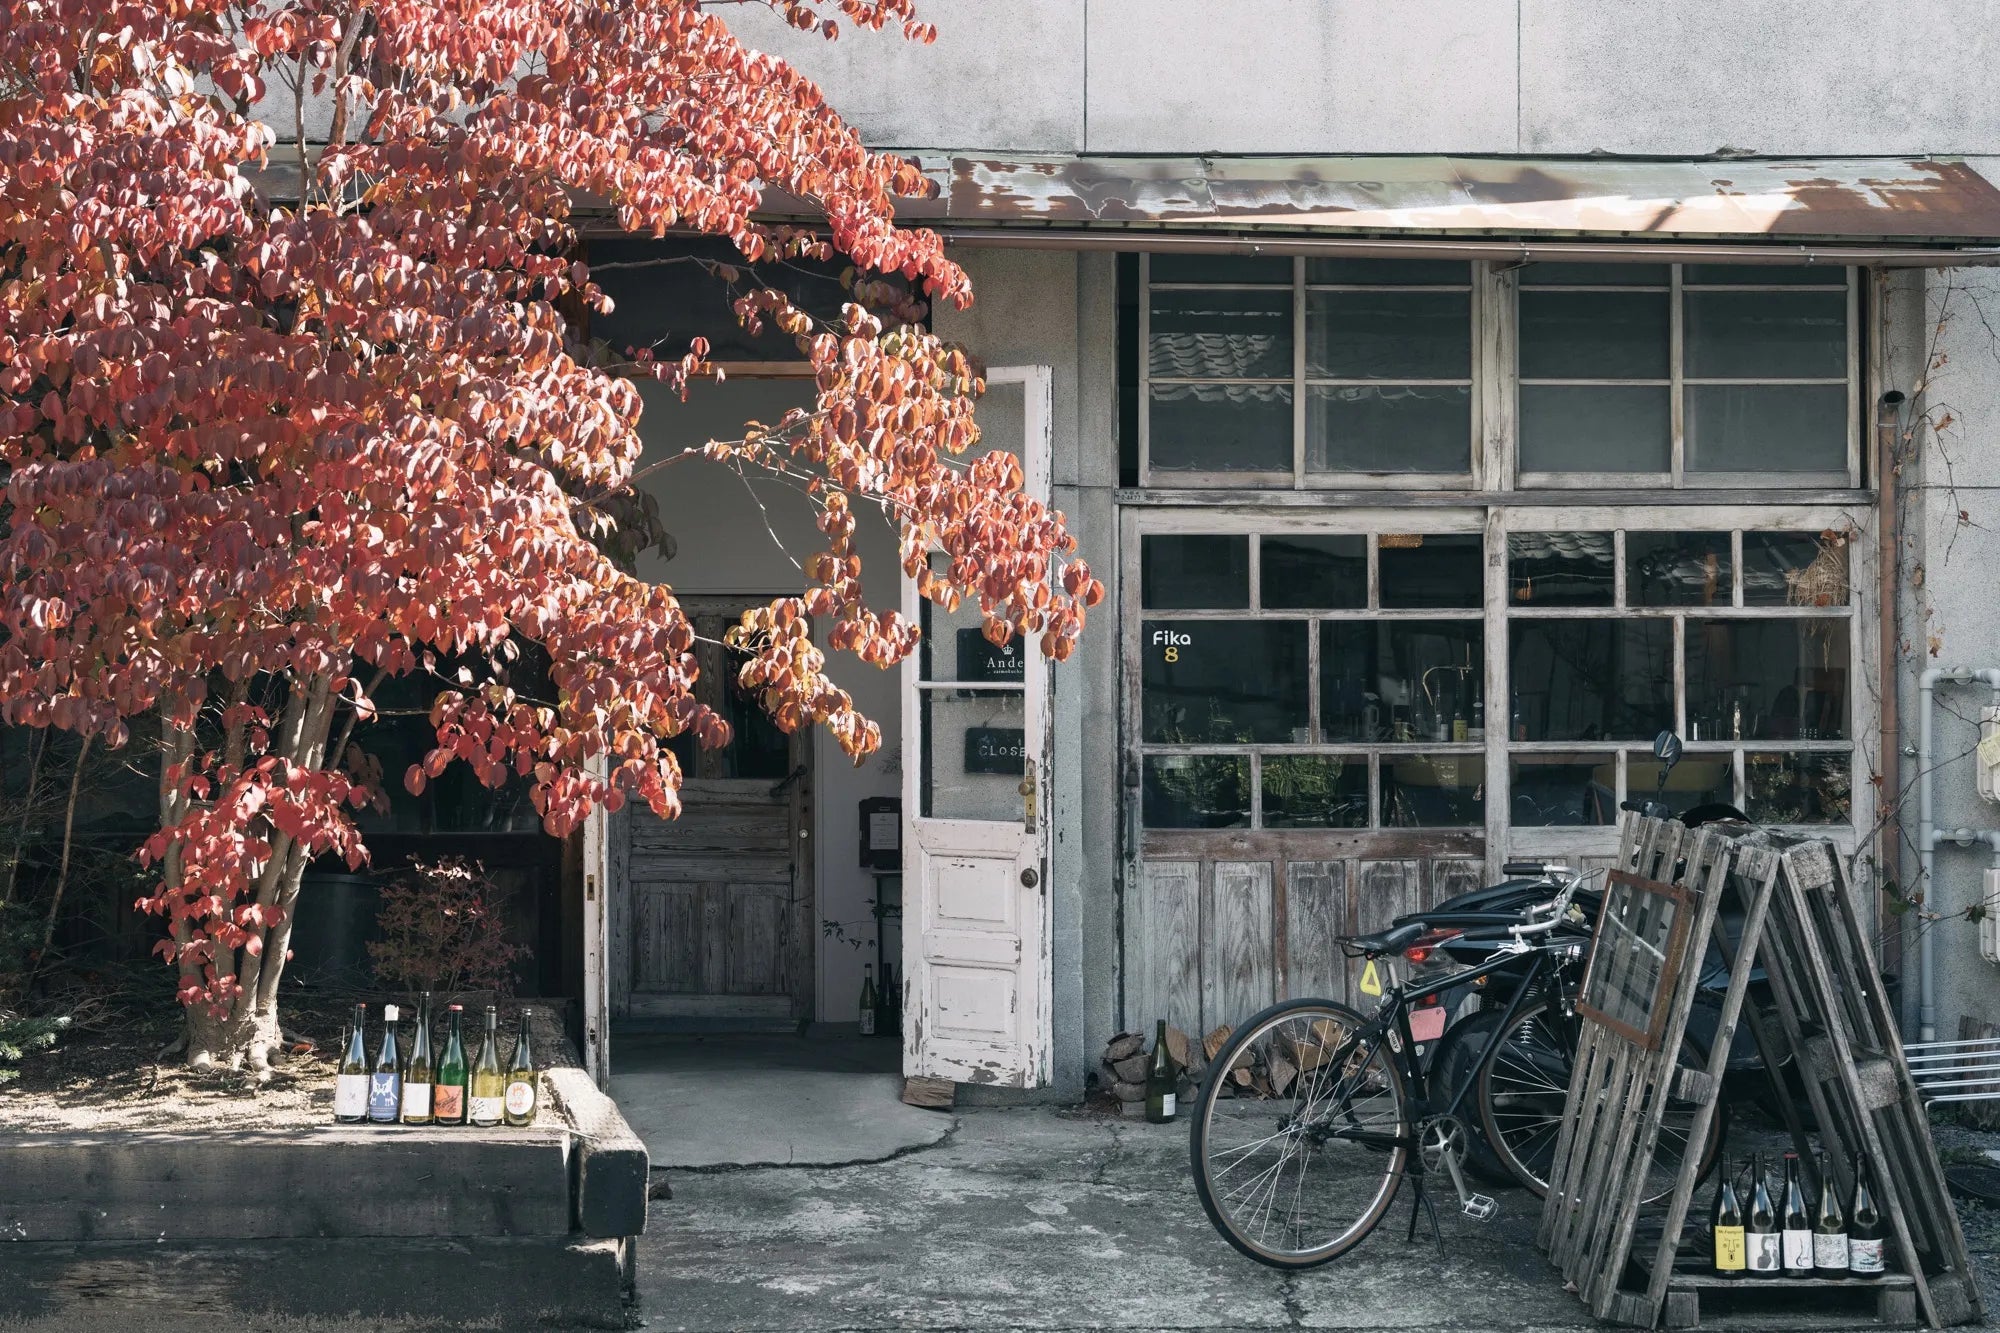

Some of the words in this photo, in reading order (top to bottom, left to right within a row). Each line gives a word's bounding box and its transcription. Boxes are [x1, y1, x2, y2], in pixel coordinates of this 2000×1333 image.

[1153, 630, 1191, 645] Fika
[1165, 646, 1179, 662] 8
[987, 657, 1024, 668] Ande
